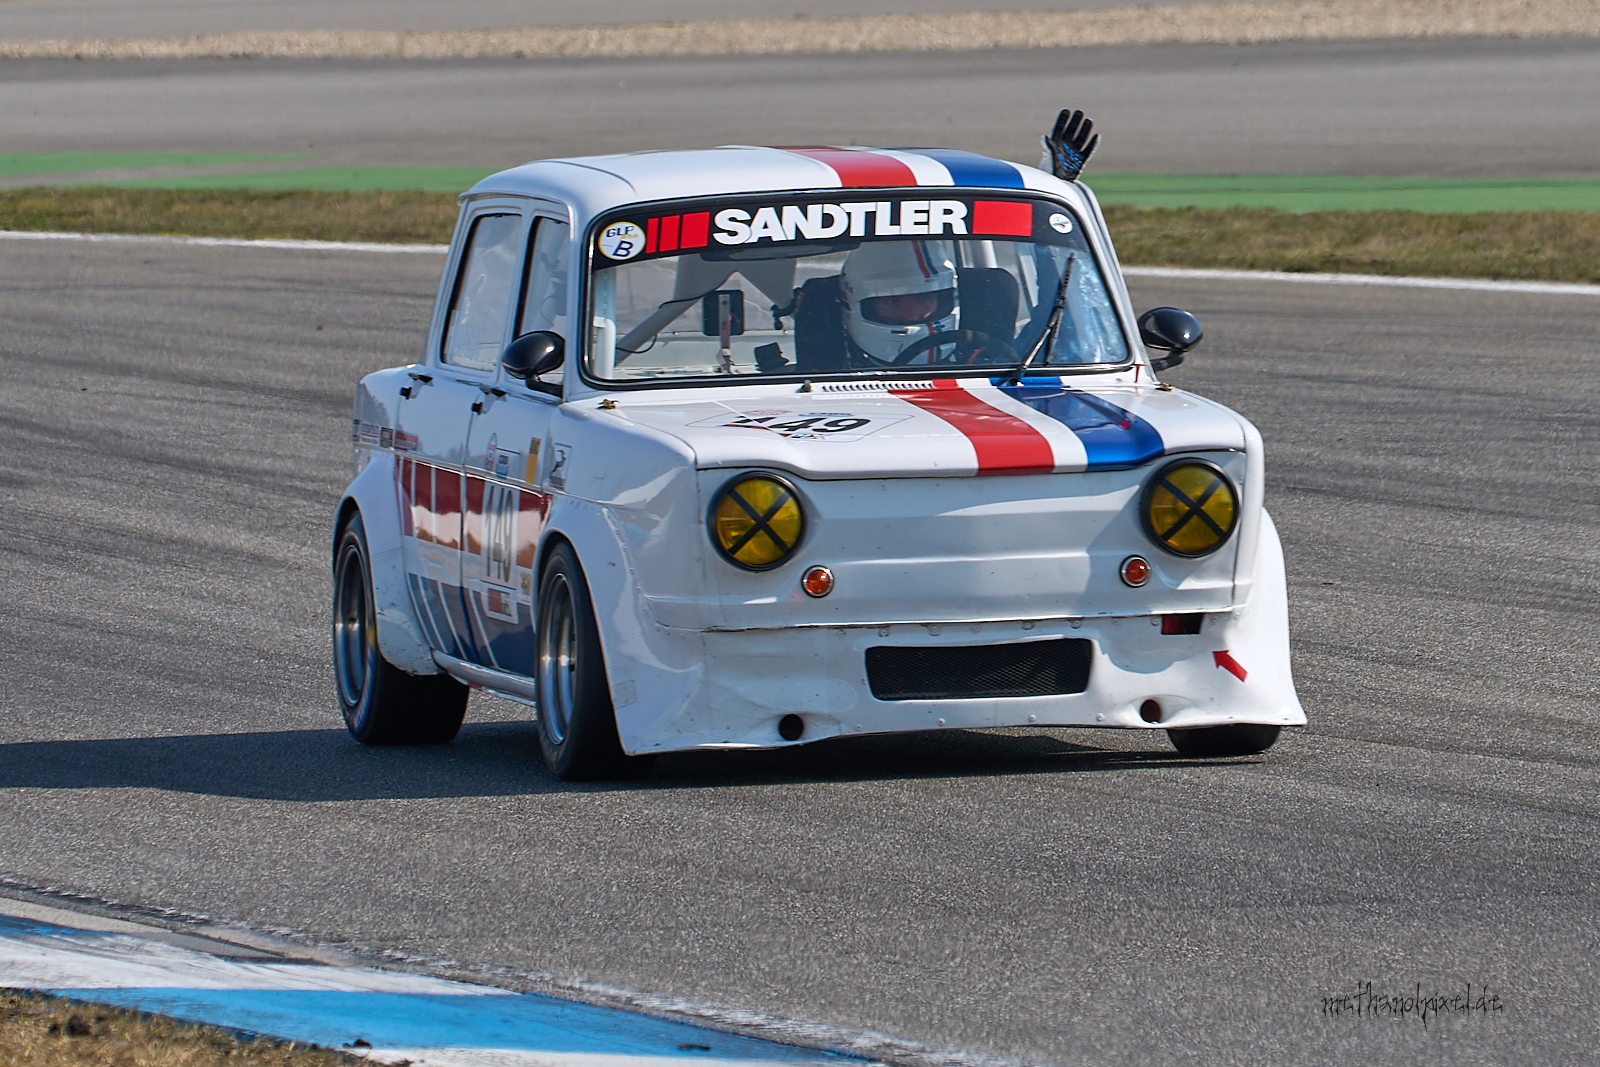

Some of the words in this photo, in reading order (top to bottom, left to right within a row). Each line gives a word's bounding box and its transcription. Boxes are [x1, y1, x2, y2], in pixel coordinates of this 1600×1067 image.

[606, 225, 634, 238] GLP
[713, 200, 968, 246] SANDTLER
[612, 240, 634, 257] B
[485, 485, 513, 584] 149
